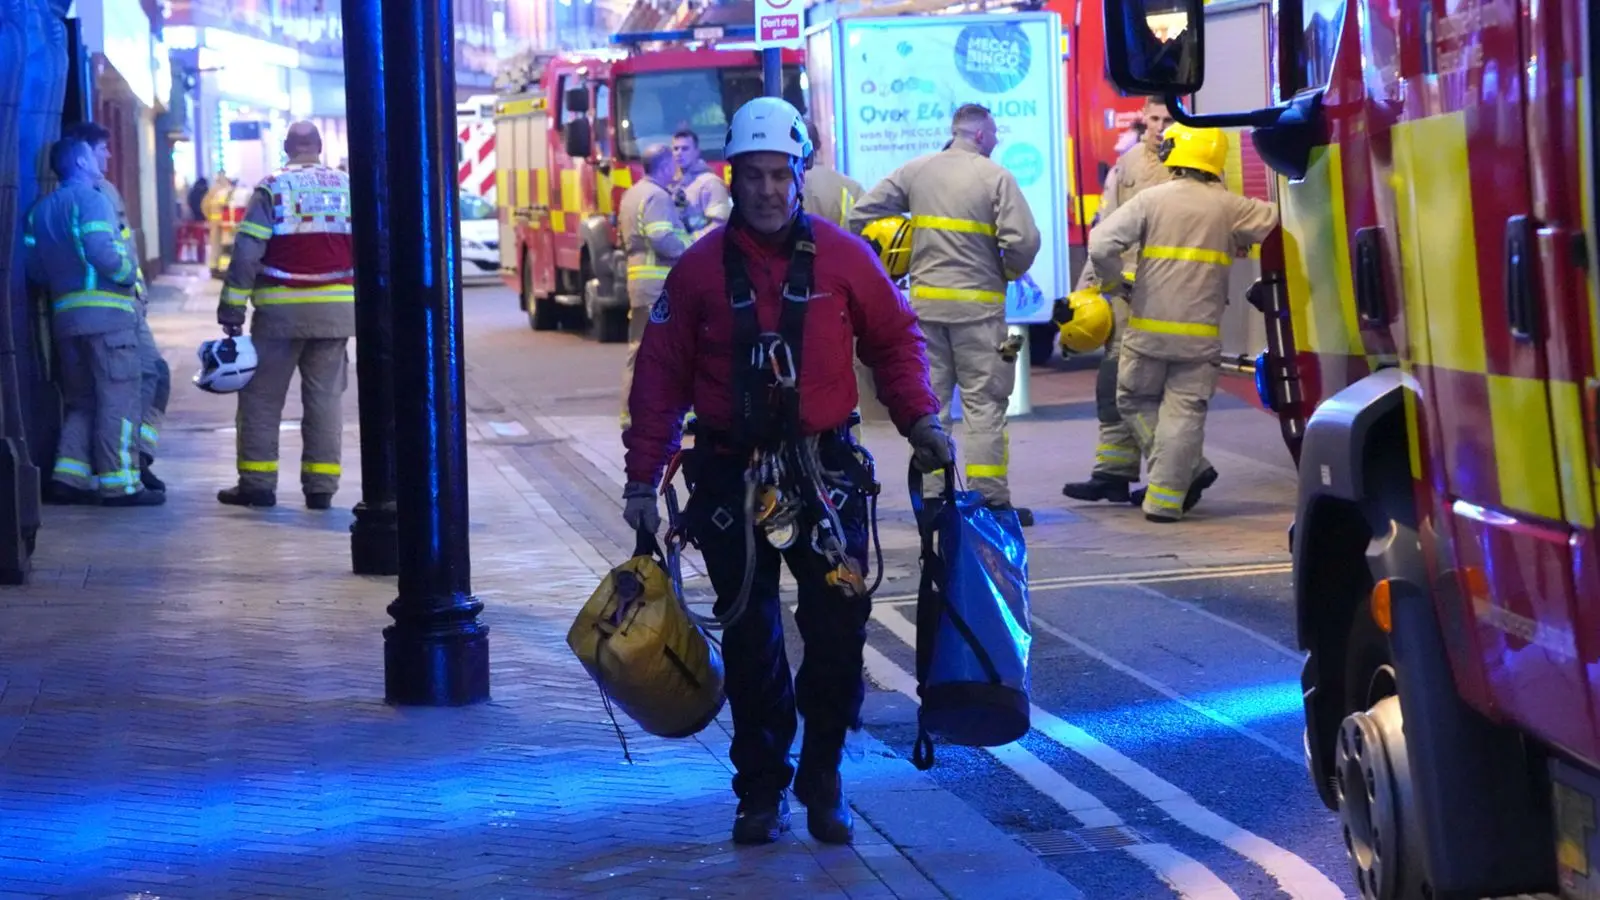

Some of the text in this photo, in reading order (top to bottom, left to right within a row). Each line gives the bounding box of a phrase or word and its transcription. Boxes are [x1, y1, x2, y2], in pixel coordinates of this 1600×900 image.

[763, 17, 797, 28] Don't drop
[773, 29, 787, 40] gum
[968, 37, 1019, 53] MECCA
[967, 49, 1019, 66] BINGO
[859, 105, 911, 125] Over
[917, 102, 945, 120] £4
[860, 131, 882, 140] won
[884, 128, 898, 141] by
[901, 127, 942, 138] MECCA
